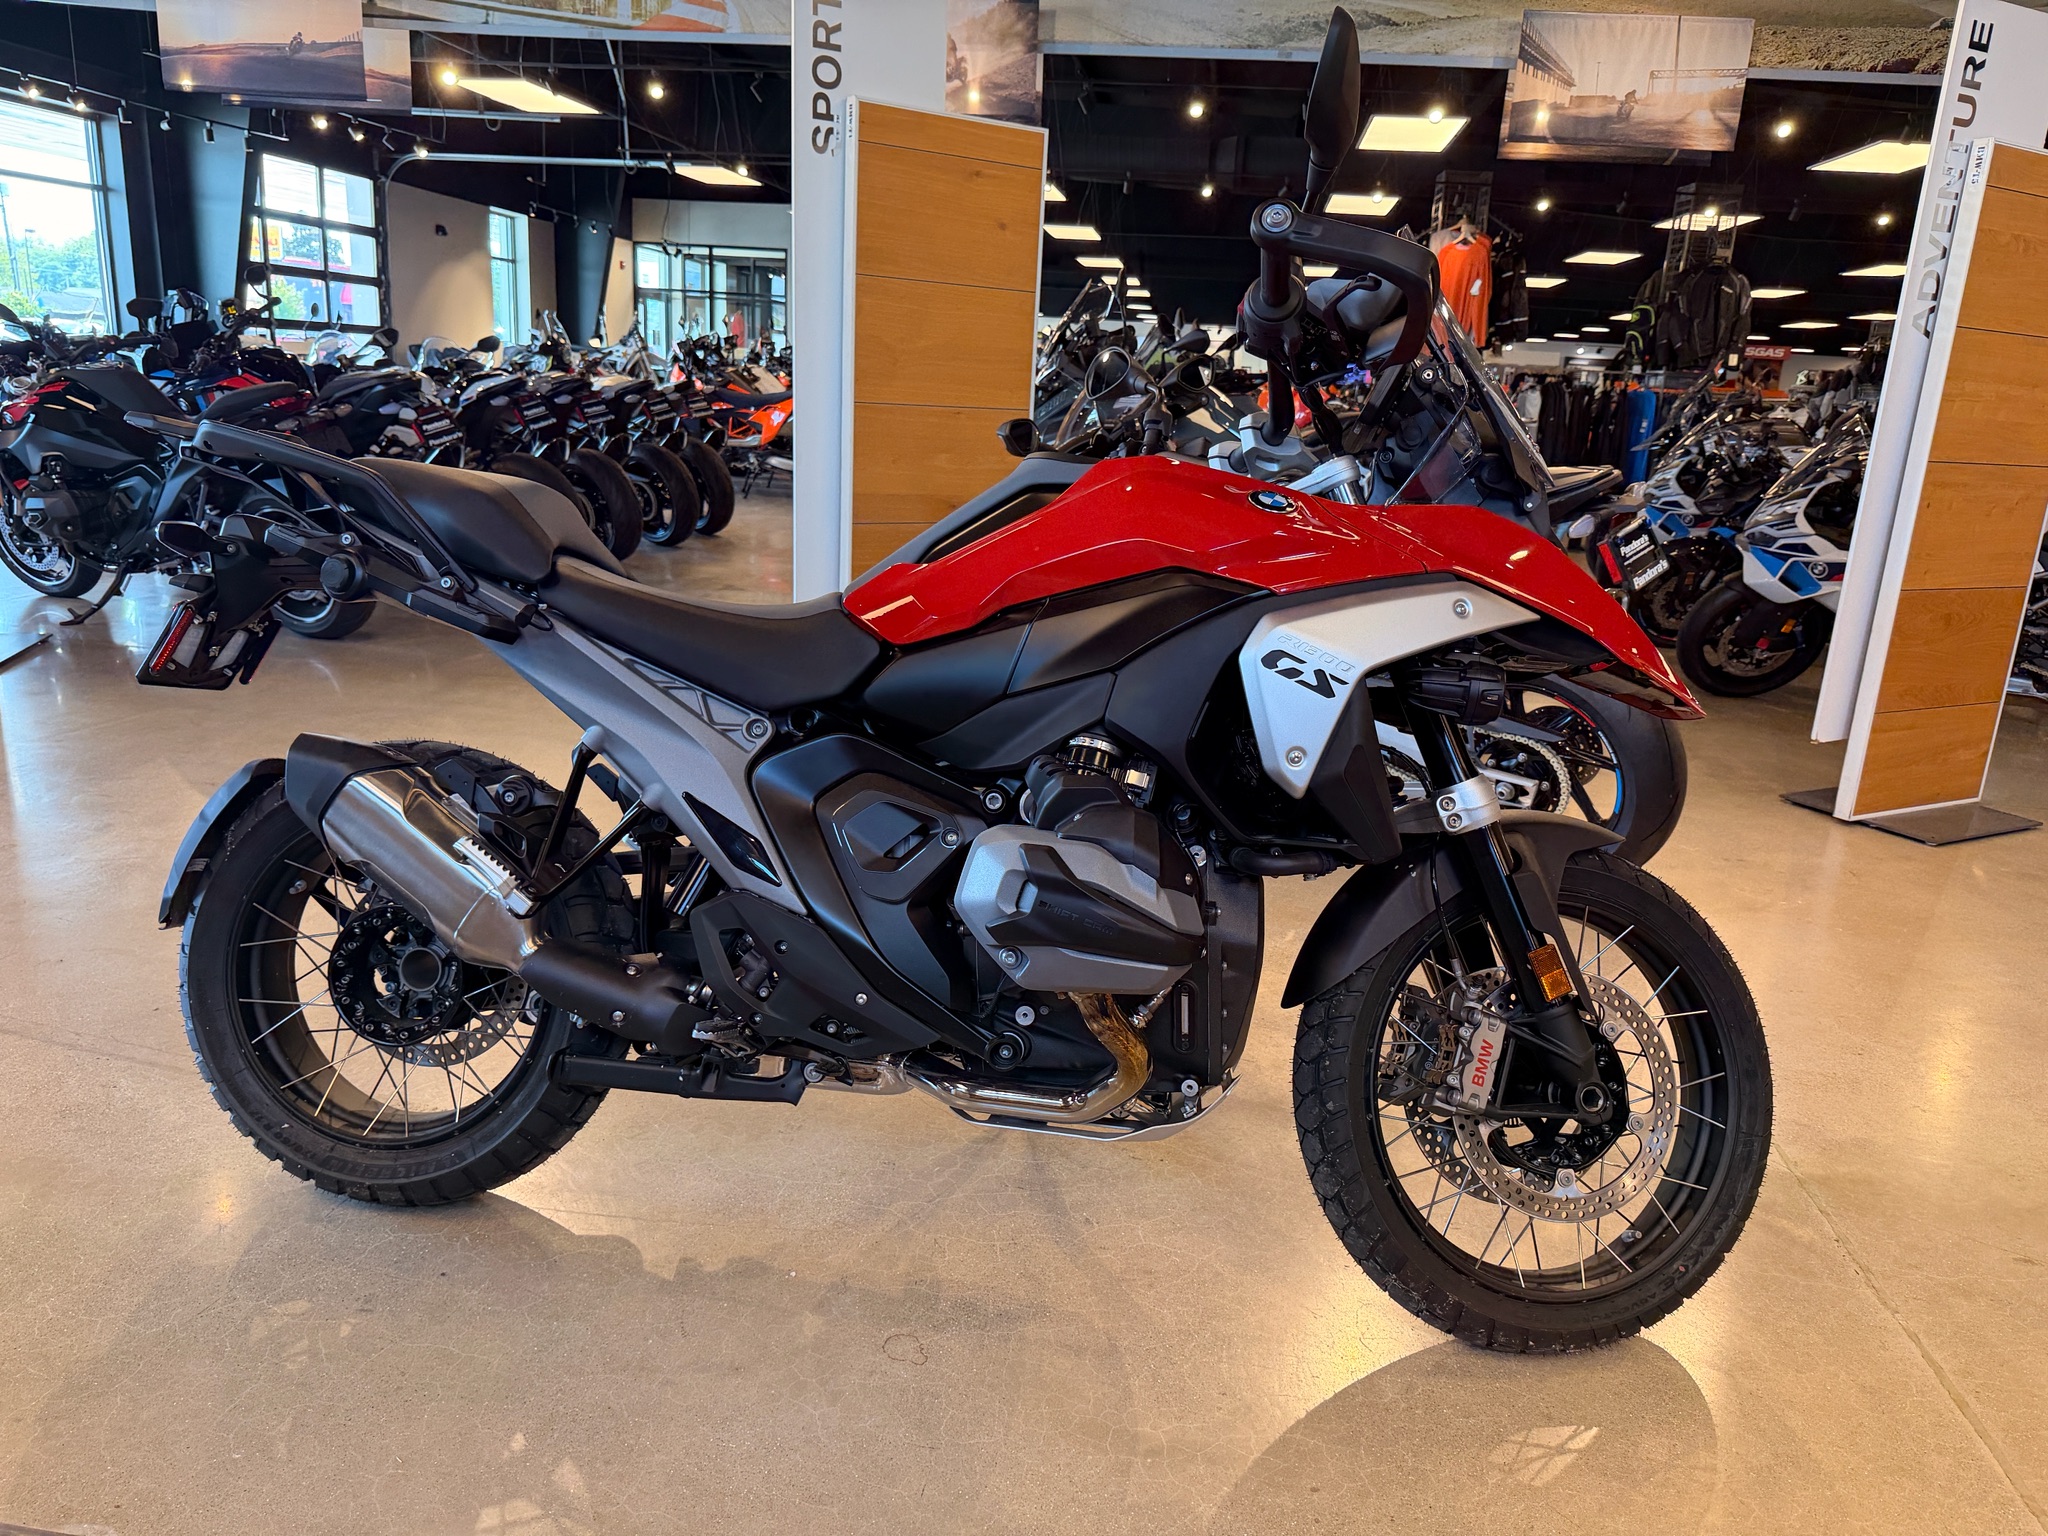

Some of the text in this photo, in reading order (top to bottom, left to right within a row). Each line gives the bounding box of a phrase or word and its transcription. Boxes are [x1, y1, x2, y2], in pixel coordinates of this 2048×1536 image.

[812, 0, 842, 157] SPORT
[1912, 19, 1994, 339] ADVENTURE
[1620, 534, 1649, 556] Pandora's
[1633, 559, 1669, 590] Pandora's
[1261, 649, 1349, 698] GS
[1037, 900, 1079, 921] SHIFT
[1472, 1039, 1494, 1087] BMW
